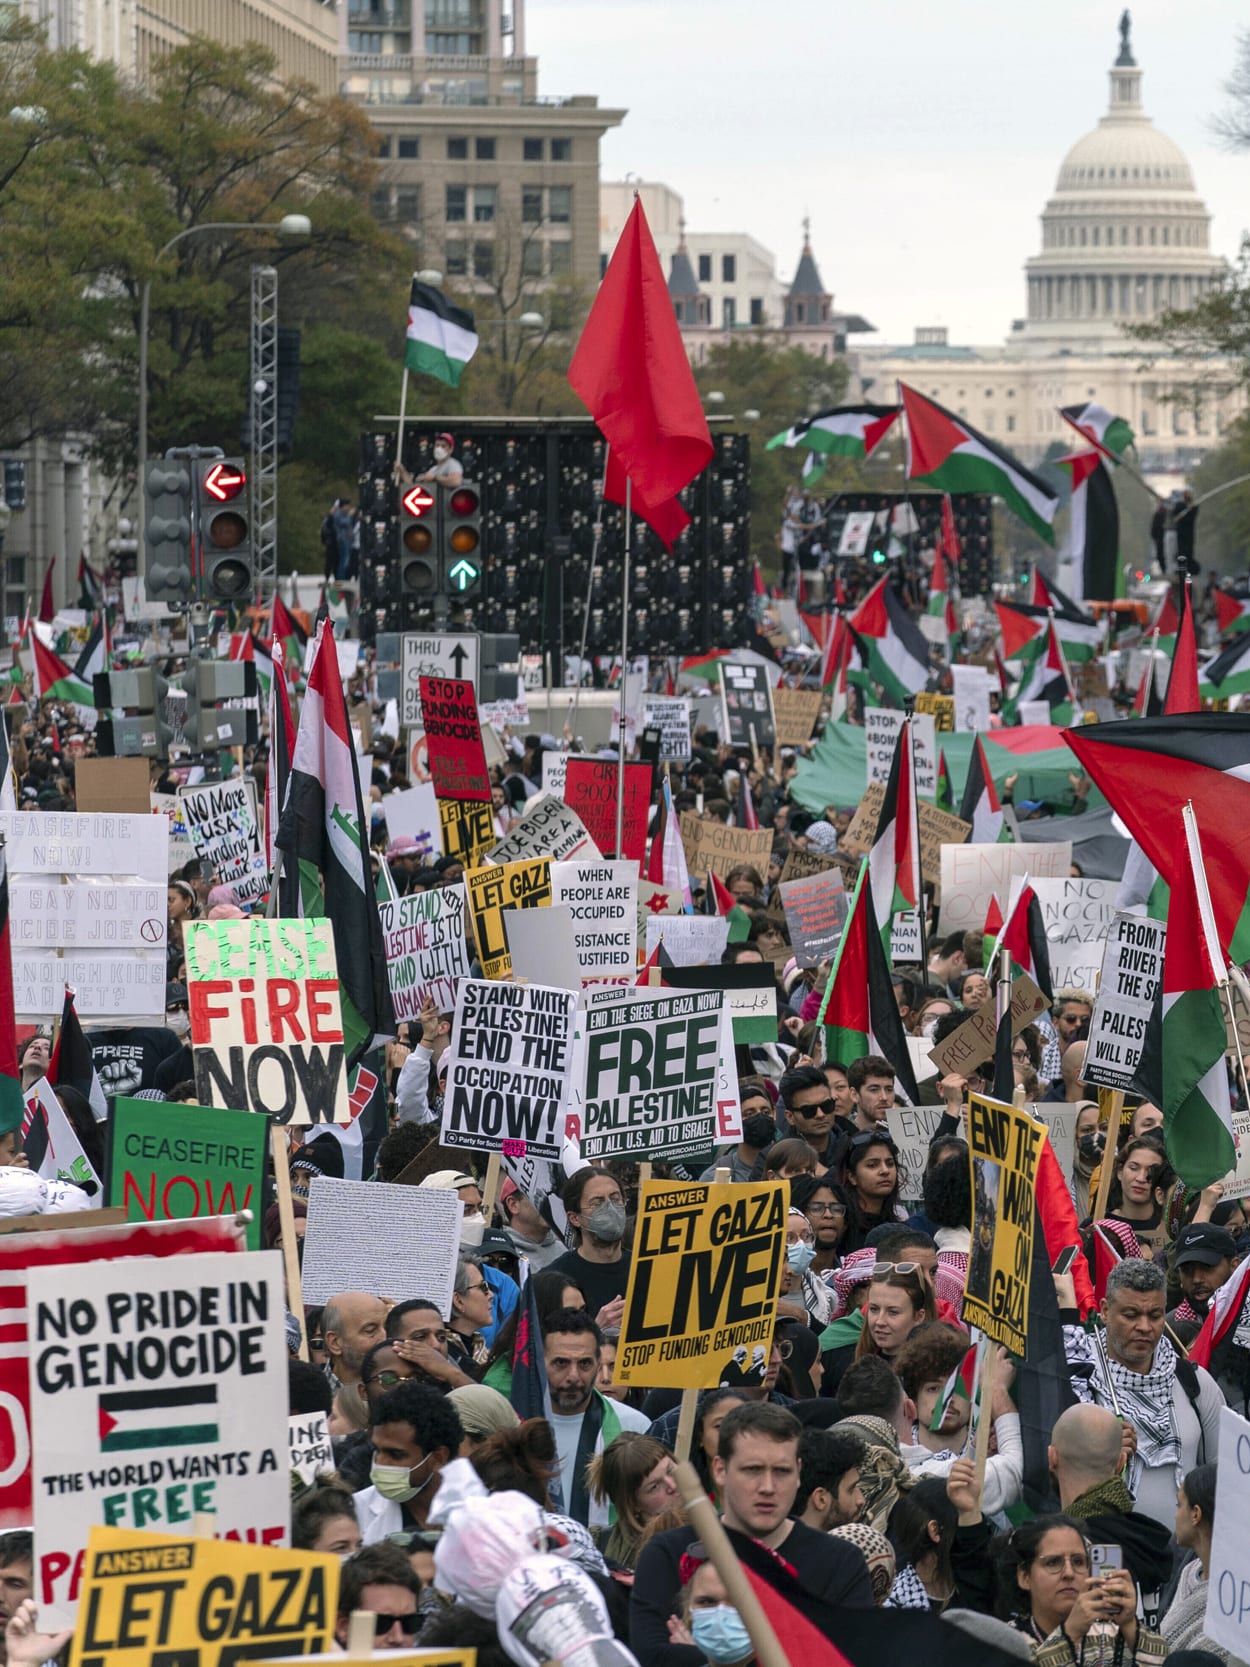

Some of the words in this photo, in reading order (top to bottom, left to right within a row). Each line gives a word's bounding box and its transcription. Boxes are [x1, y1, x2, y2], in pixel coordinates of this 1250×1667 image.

[408, 640, 441, 655] THRU
[429, 681, 465, 699] STOP
[424, 721, 479, 741] GENOCIDE
[868, 715, 897, 727] STOP
[184, 794, 208, 826] NO
[210, 788, 247, 818] More
[520, 800, 566, 837] BIDEN
[194, 839, 248, 867] Funding
[248, 825, 261, 853] 4
[201, 816, 239, 840] USA
[33, 846, 92, 866] NOW!
[471, 868, 504, 886] ANSWER
[578, 868, 613, 882] WHEN
[1064, 880, 1105, 899] NO
[30, 890, 75, 910] SAY
[88, 890, 118, 910] NO
[130, 891, 159, 911] TO
[400, 888, 442, 928] STAND
[472, 881, 504, 912] LET
[561, 887, 603, 901] PEOPLE
[606, 886, 630, 900] ARE
[88, 920, 133, 940] JOE
[1118, 921, 1158, 950] FROM
[186, 917, 336, 982] CEASE
[420, 940, 464, 981] WITH
[1118, 948, 1156, 976] RIVER
[111, 962, 165, 985] KIDS
[1118, 972, 1142, 998] THE
[464, 983, 524, 1010] STAND
[530, 991, 570, 1016] WITH
[591, 1011, 609, 1029] END
[612, 1007, 631, 1025] THE
[634, 1004, 654, 1022] SIEGE
[657, 1002, 670, 1018] ON
[673, 998, 697, 1016] GAZA
[699, 993, 721, 1013] NOW!
[593, 989, 625, 1004] ANSWER
[461, 1006, 569, 1040] PALESTINE!
[92, 1045, 144, 1061] FREE
[458, 1028, 512, 1063] END
[521, 1035, 566, 1073] THE
[587, 1015, 718, 1099] FREE
[1096, 1041, 1121, 1063] WILL
[1124, 1049, 1140, 1067] BE
[194, 1044, 346, 1126] NOW
[454, 1065, 563, 1100] OCCUPATION
[450, 1087, 559, 1144] NOW!
[586, 1082, 713, 1134] PALESTINE!
[125, 1133, 256, 1170] CEASEFIRE
[586, 1136, 602, 1157] END
[605, 1134, 624, 1154] ALL
[627, 1131, 647, 1151] U.S.
[650, 1127, 665, 1146] AID
[667, 1125, 679, 1143] TO
[682, 1119, 712, 1140] ISRAEL
[971, 1100, 1011, 1162] END
[1013, 1117, 1041, 1182] THE
[124, 1170, 254, 1222] NOW
[648, 1190, 705, 1210] ANSWER
[1002, 1167, 1033, 1237] WAR
[638, 1208, 703, 1259] LET
[709, 1188, 784, 1247] GAZA
[1014, 1232, 1030, 1285] ON
[625, 1231, 783, 1344] LIVE!
[991, 1269, 1026, 1333] GAZA
[37, 1297, 97, 1341] NO
[107, 1286, 219, 1334] PRIDE
[228, 1280, 268, 1324] IN
[37, 1326, 266, 1394] GENOCIDE
[622, 1346, 654, 1368] STOP
[659, 1335, 709, 1361] FUNDING
[713, 1318, 771, 1352] GENOCIDE!
[42, 1471, 84, 1496] THE
[88, 1461, 164, 1488] WORLD
[168, 1451, 251, 1481] WANTS
[258, 1448, 278, 1474] A
[103, 1481, 218, 1528] FREE
[98, 1547, 191, 1575] ANSWER
[84, 1579, 187, 1652] LET
[197, 1565, 326, 1642] GAZA
